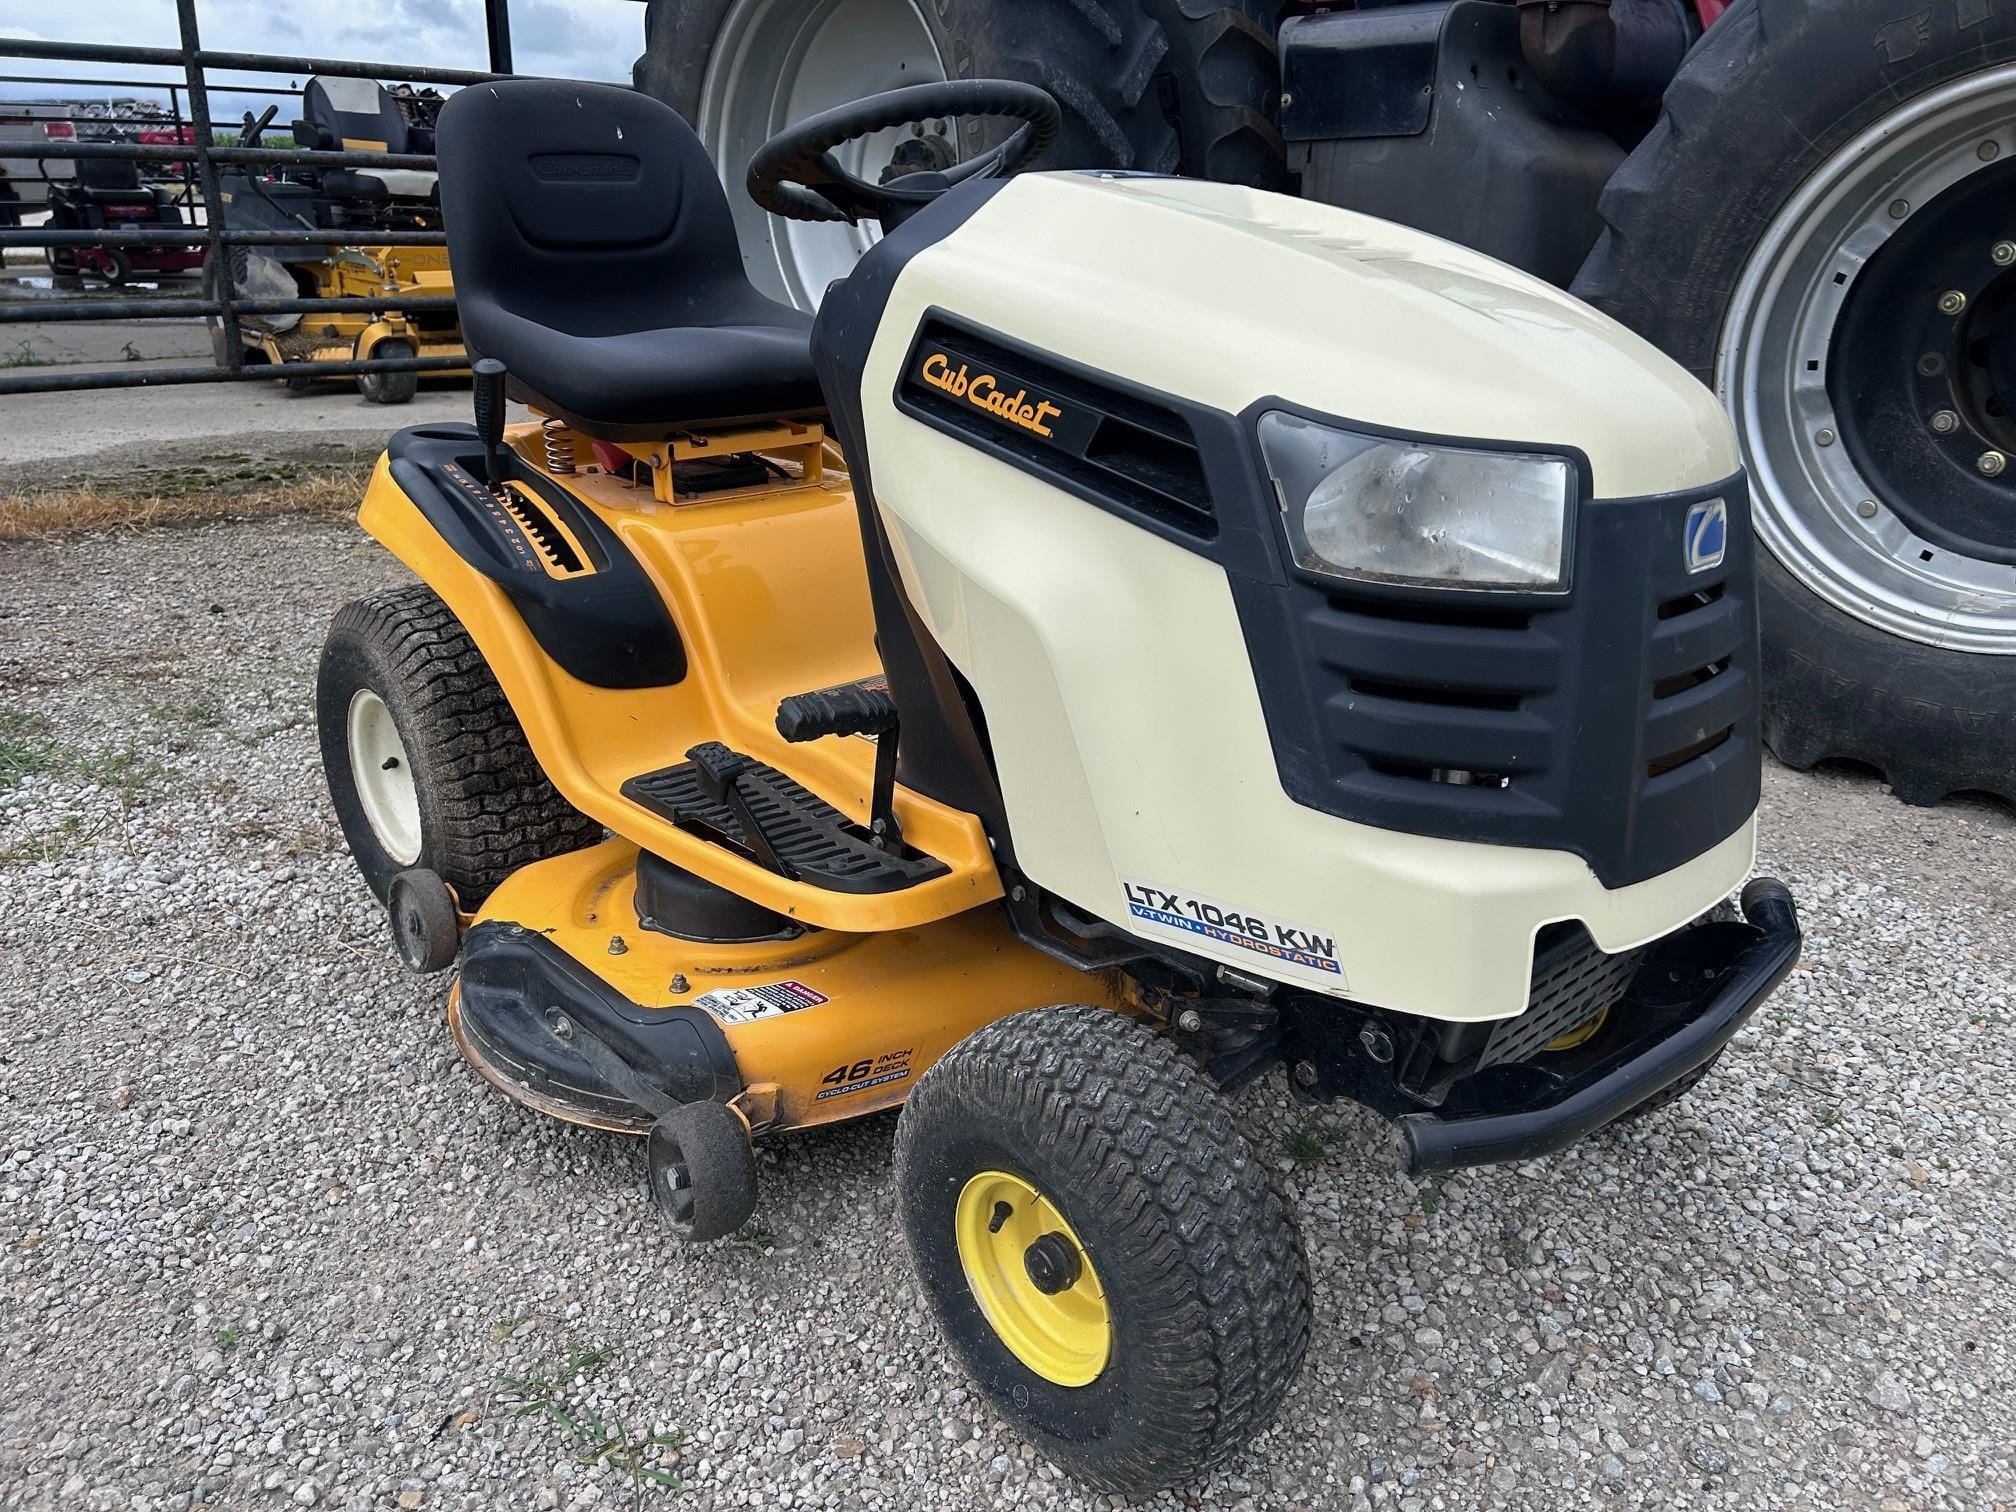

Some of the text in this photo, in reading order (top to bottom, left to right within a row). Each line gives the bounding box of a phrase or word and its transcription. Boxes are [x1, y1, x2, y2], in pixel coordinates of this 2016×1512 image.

[922, 353, 1062, 437] Cub Cadet
[1123, 882, 1334, 958] LTX 1046 KW
[1131, 905, 1337, 971] V-TWIN HYDROSTATIC
[794, 986, 824, 1003] DANGER
[821, 1047, 914, 1085] 46 INCH
[870, 1069, 908, 1085] SYSTEM
[873, 1058, 911, 1075] DECK
